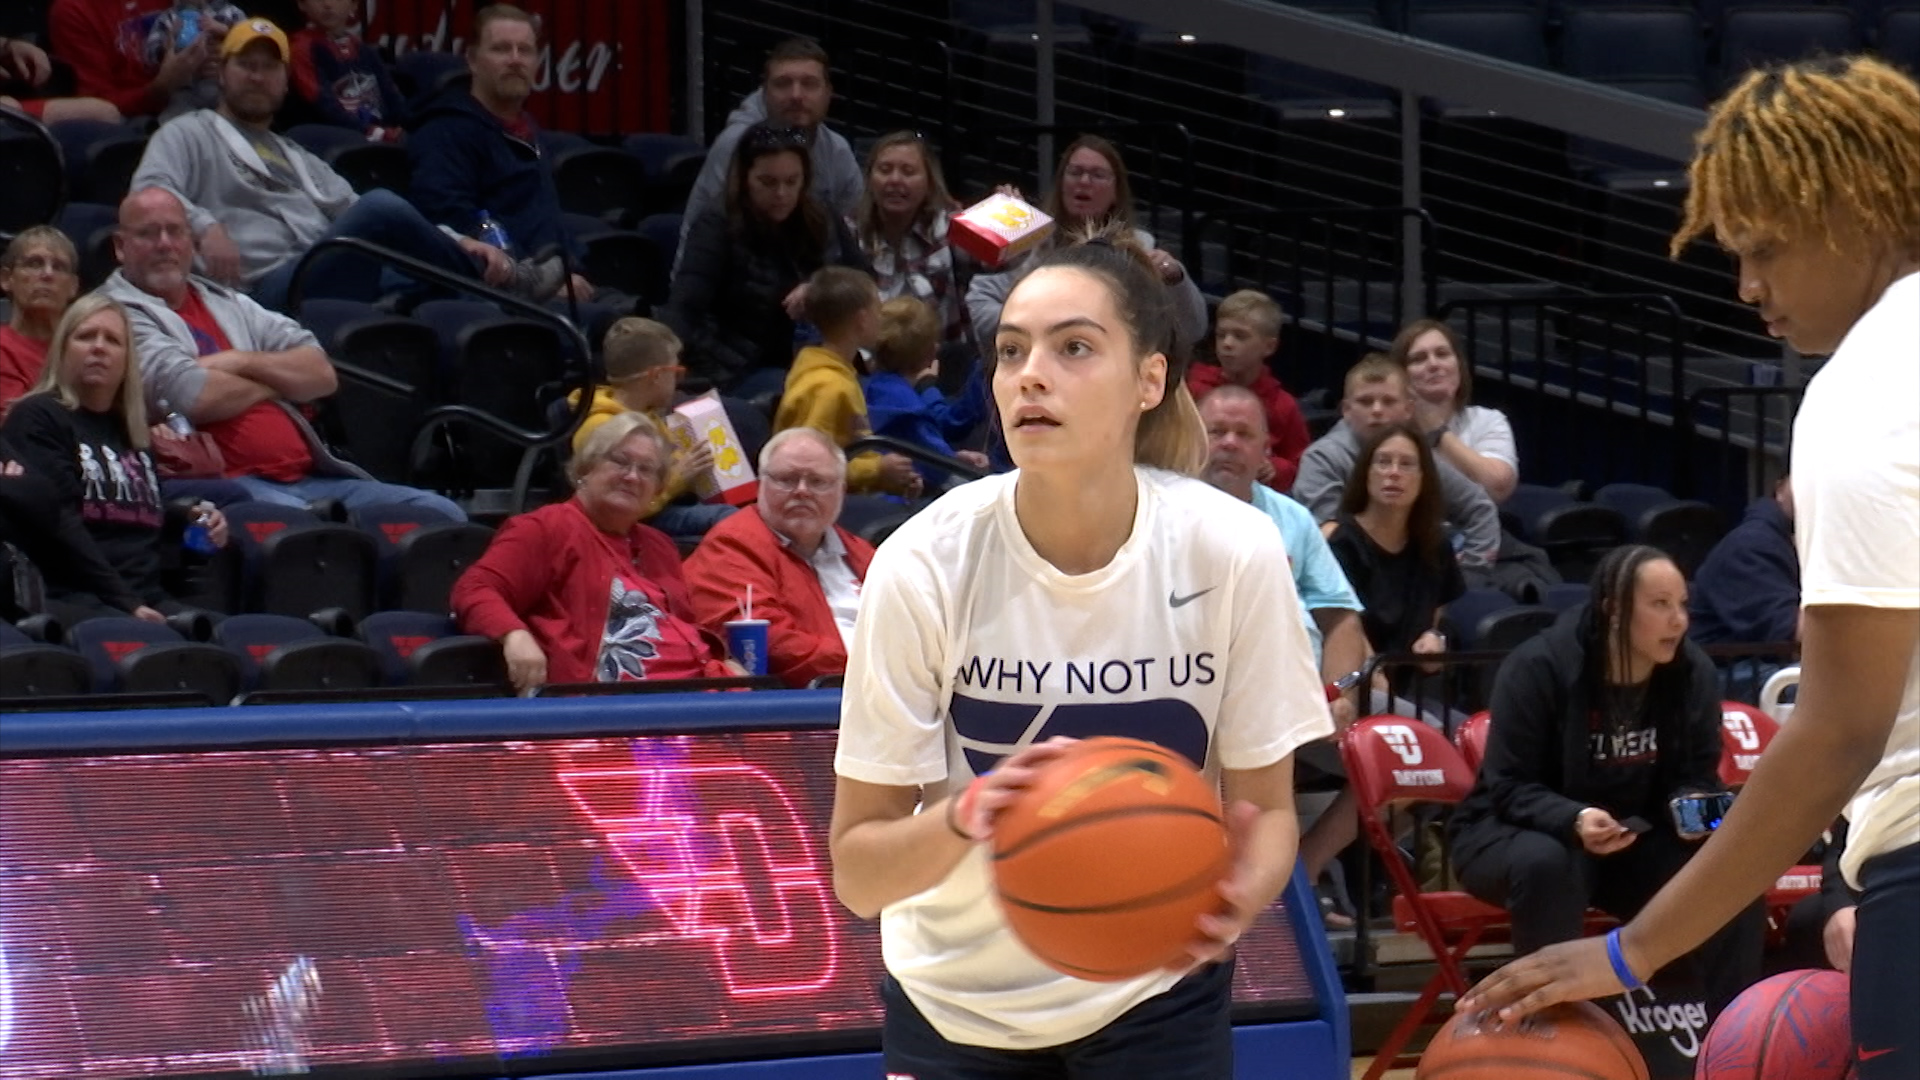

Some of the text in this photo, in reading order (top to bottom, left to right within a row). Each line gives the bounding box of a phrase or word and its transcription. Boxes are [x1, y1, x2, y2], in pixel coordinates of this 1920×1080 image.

[955, 652, 1216, 694] WHY NOT US
[1618, 984, 1709, 1058] Kroger
